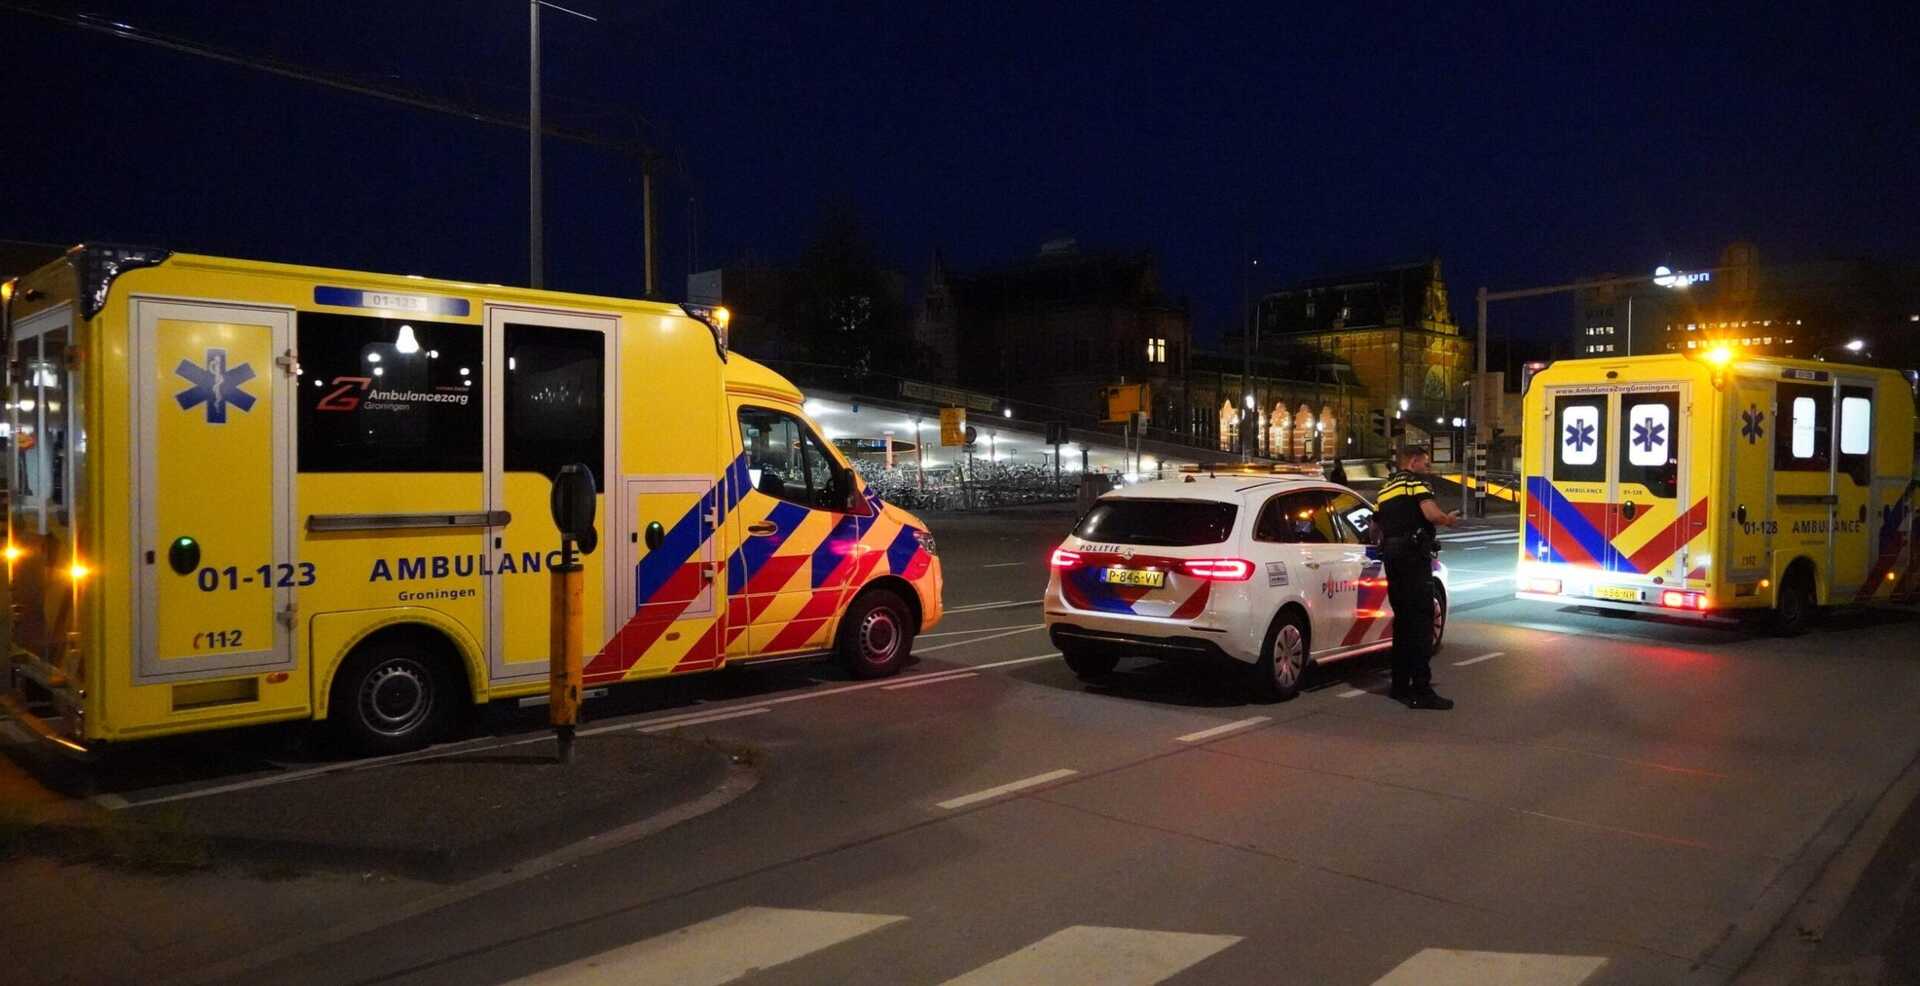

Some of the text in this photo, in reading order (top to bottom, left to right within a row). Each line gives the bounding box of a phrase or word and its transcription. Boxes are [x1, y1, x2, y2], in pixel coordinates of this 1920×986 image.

[368, 388, 469, 405] Ambulancezorg
[363, 401, 411, 411] Groningen
[1744, 520, 1779, 535] 01-128
[1080, 544, 1121, 553] POLITIE
[198, 562, 316, 592] 01-123
[1109, 570, 1160, 585] P-846-VV
[398, 588, 476, 601] Groningen
